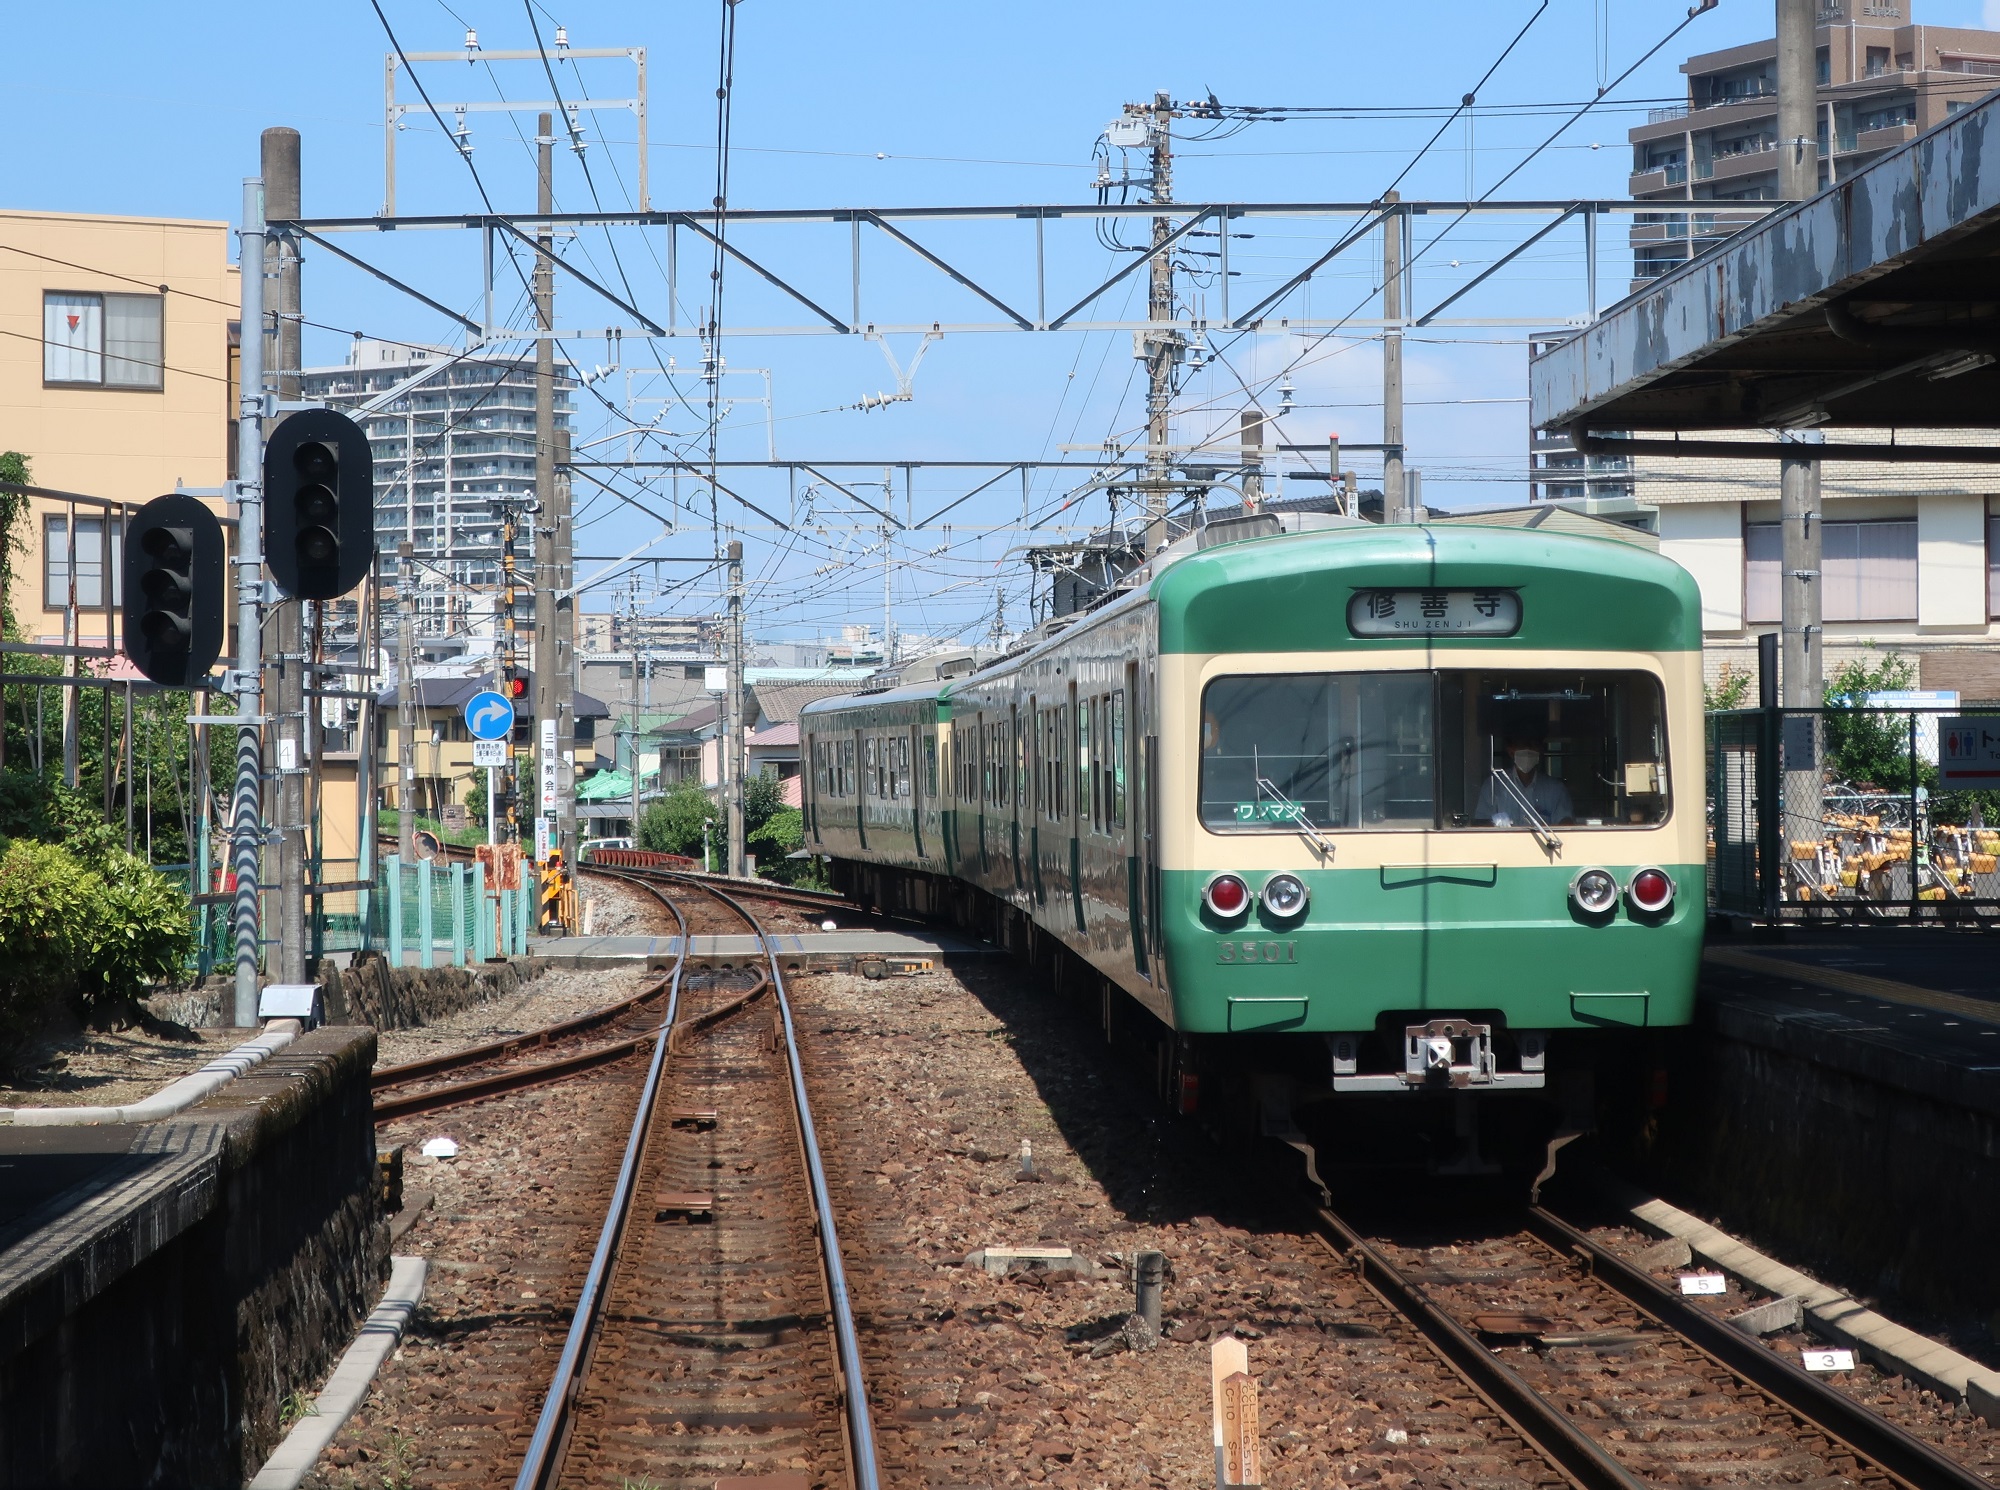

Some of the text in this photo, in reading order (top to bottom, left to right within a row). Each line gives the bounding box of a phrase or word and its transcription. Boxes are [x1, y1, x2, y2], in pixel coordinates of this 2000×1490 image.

[1367, 592, 1501, 619] 修善寺
[280, 746, 292, 762] 4
[545, 732, 554, 791] 三島教会
[1240, 805, 1300, 819] ワンマン
[1218, 942, 1295, 962] 3501
[1698, 1279, 1709, 1291] 5
[1822, 1355, 1836, 1368] 3
